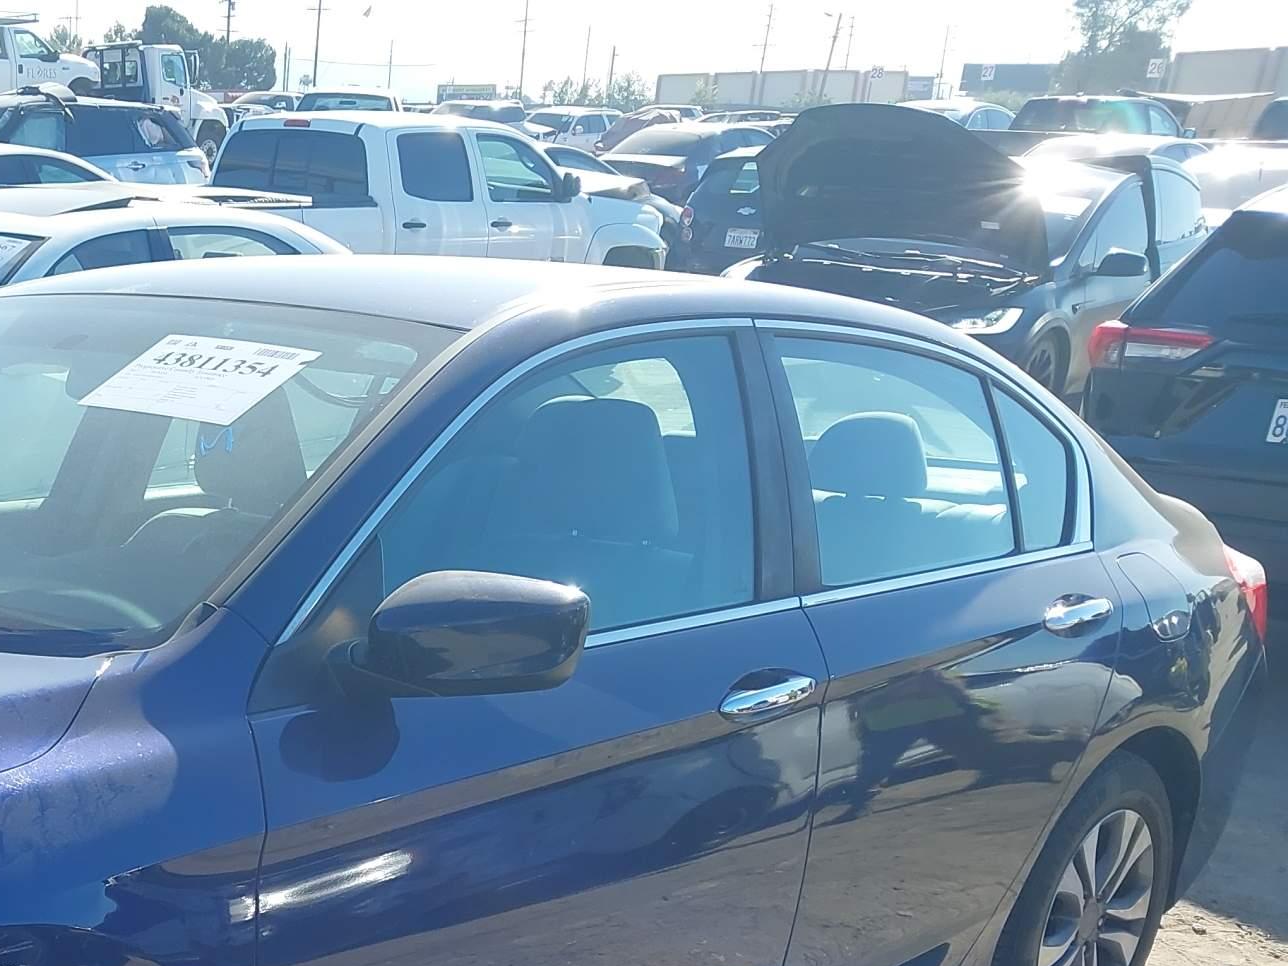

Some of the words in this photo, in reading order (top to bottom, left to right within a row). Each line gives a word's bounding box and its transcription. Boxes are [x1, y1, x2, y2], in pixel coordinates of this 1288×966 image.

[871, 67, 884, 79] 28
[982, 66, 995, 78] 27
[153, 351, 279, 378] 43811354
[1272, 415, 1288, 438] 8
